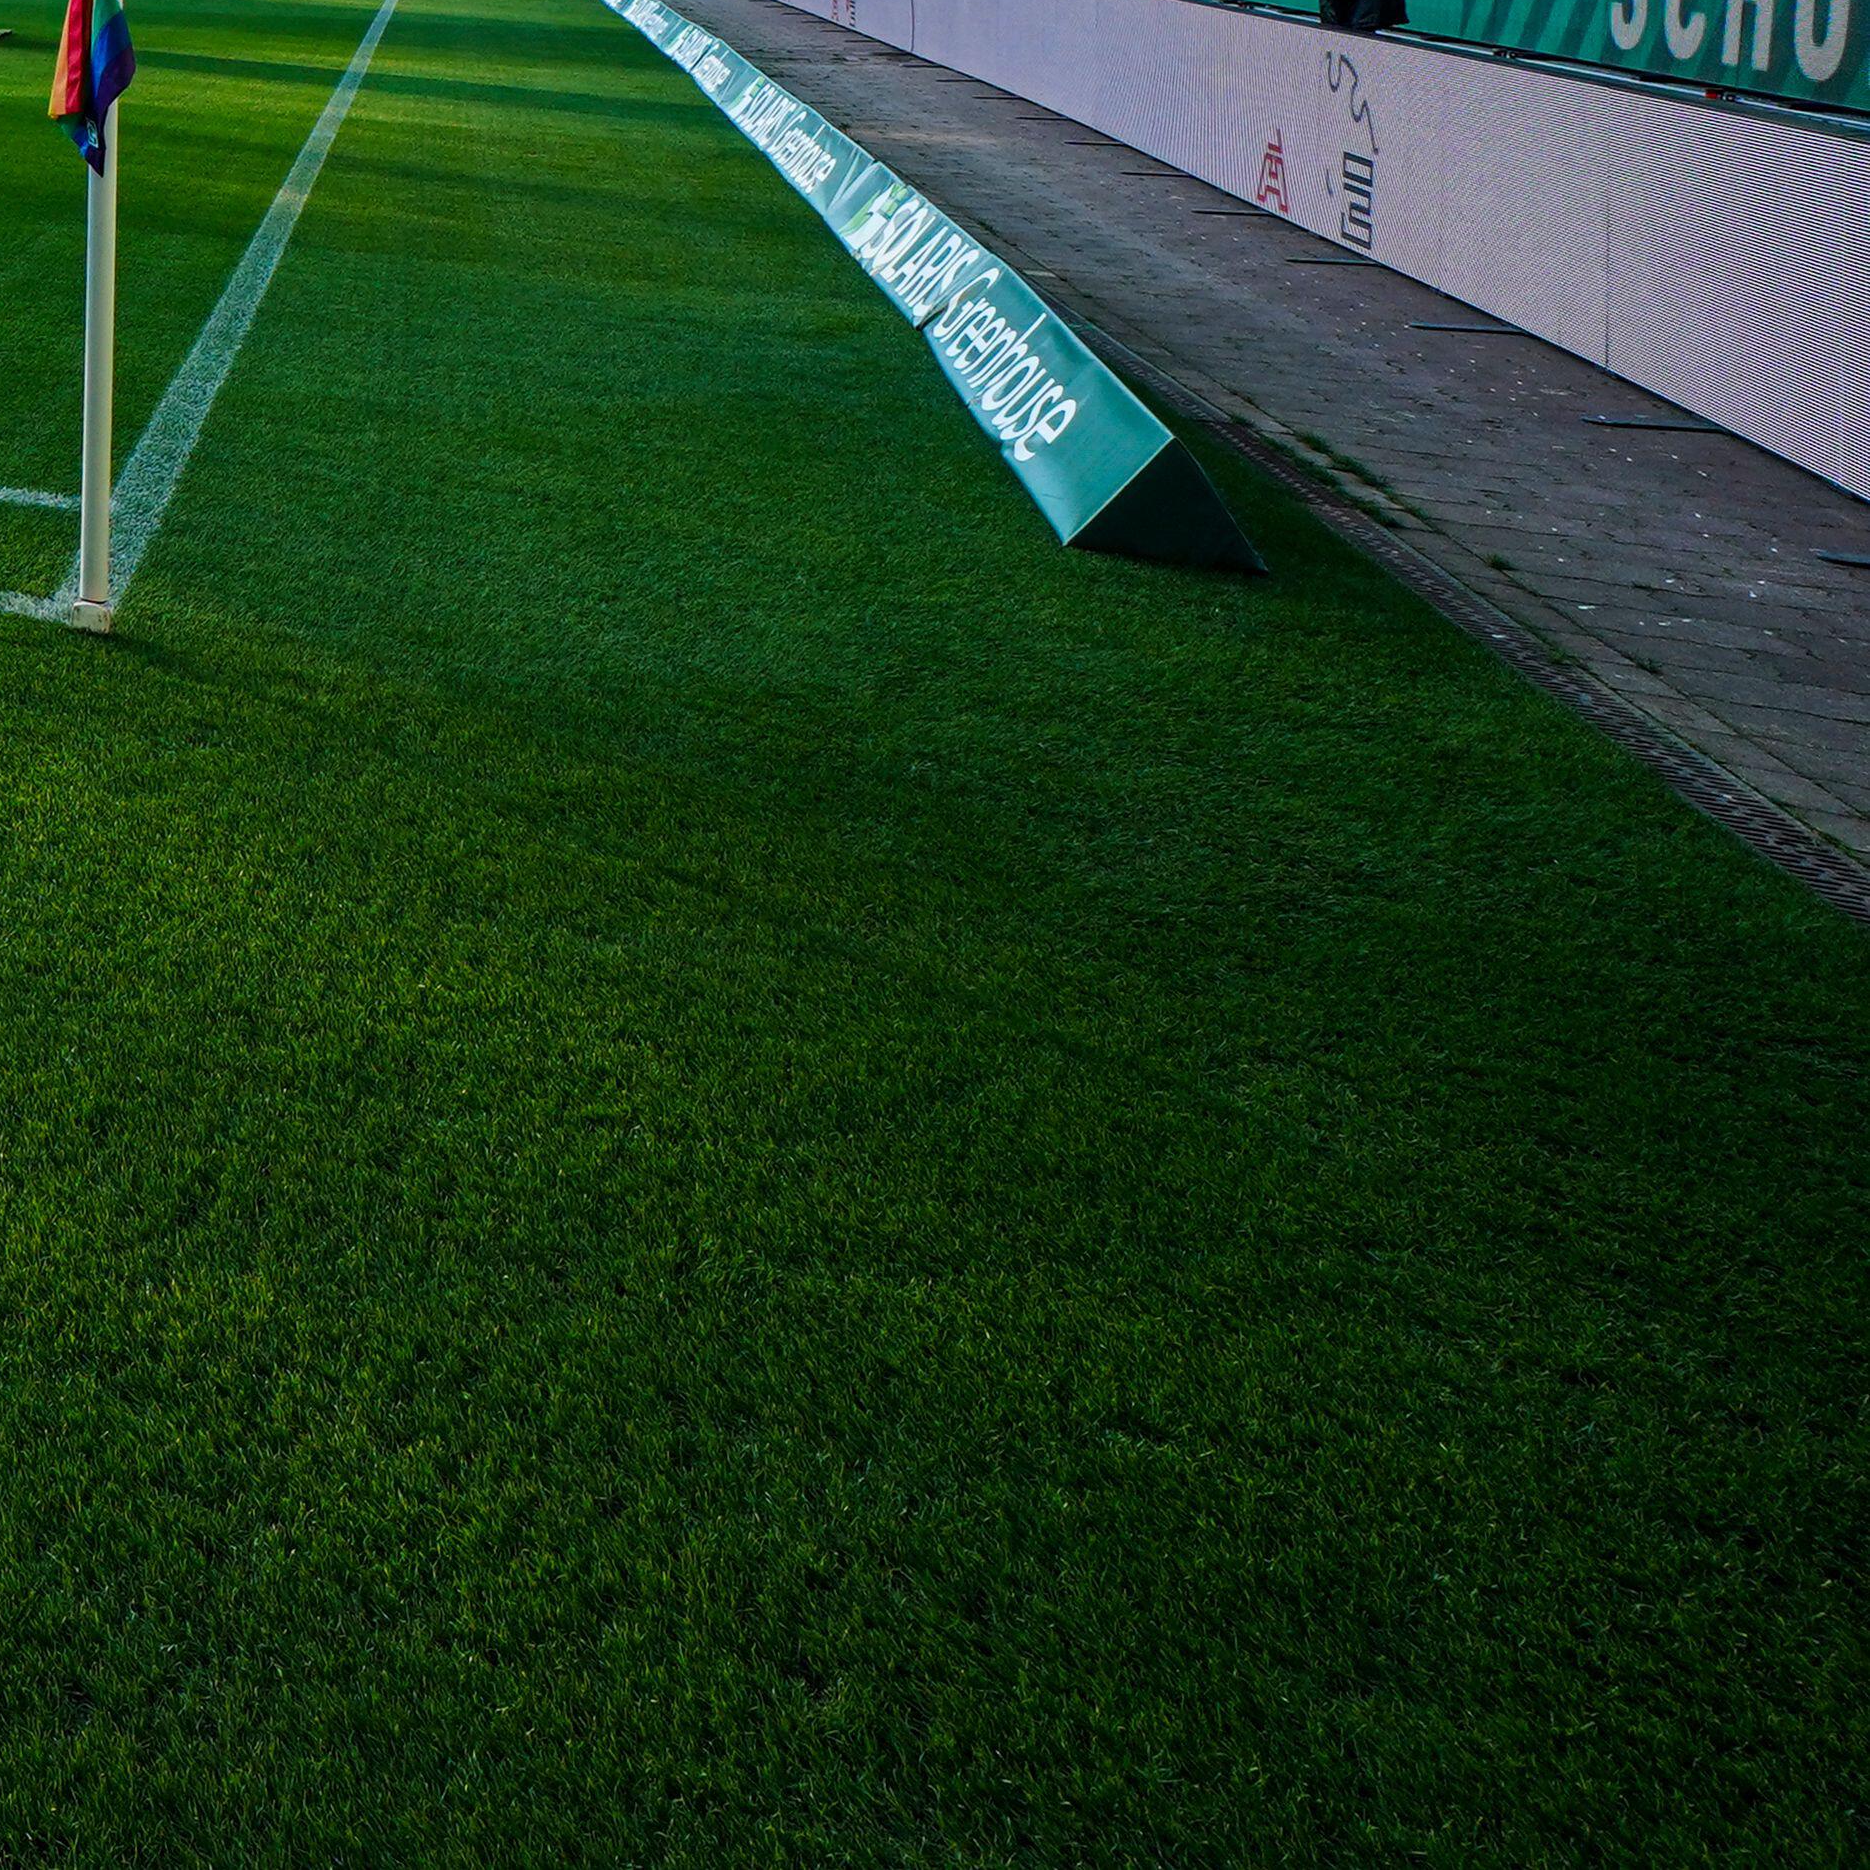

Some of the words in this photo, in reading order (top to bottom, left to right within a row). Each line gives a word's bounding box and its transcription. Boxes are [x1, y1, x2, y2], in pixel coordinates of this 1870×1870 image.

[739, 83, 798, 152] SOLARIS
[768, 110, 837, 194] Greenhouse
[861, 197, 982, 318] SOLARIS
[932, 267, 1077, 463] Greenhouse
